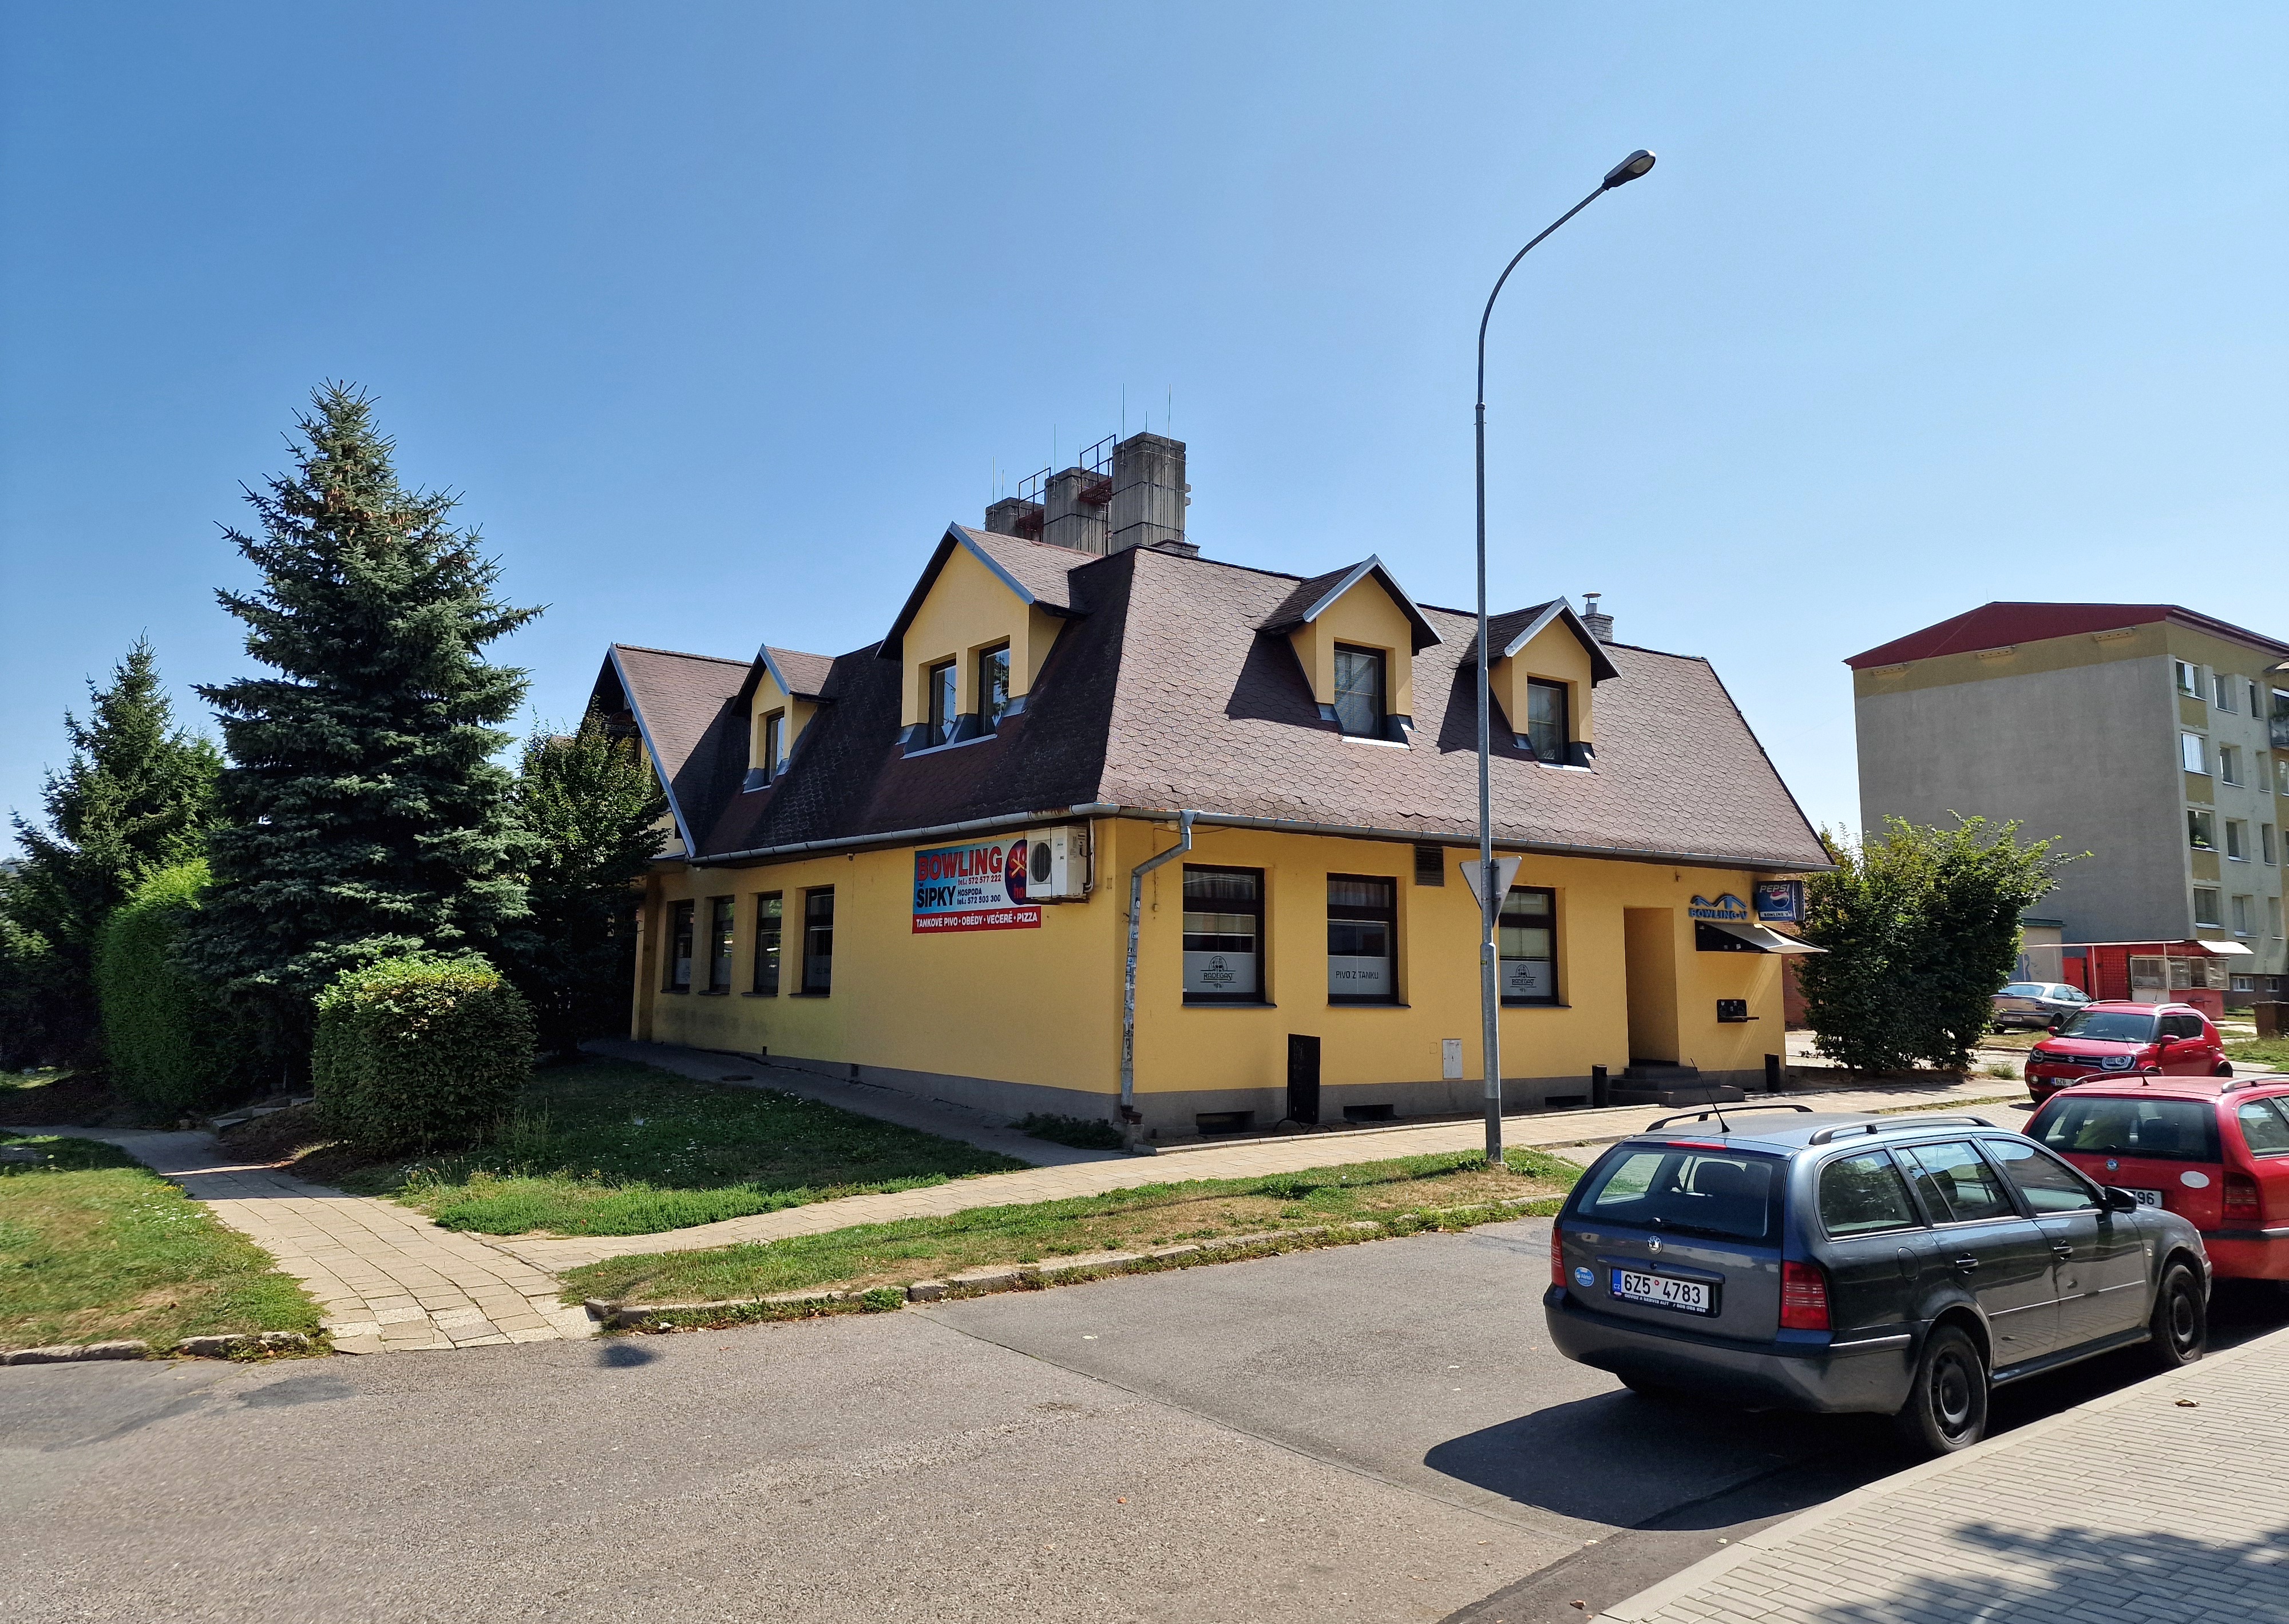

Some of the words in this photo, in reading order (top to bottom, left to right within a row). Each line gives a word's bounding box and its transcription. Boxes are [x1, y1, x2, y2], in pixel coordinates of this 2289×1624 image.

[917, 846, 1003, 881] BOWLING
[957, 888, 983, 897] HOSPODA
[1759, 884, 1790, 893] PEPSI
[916, 882, 956, 908] ŠIPKY
[967, 896, 977, 904] 572
[916, 915, 943, 928] TANKOVÉ
[944, 917, 958, 926] PIVO
[961, 913, 983, 926] OBĚDY
[1016, 912, 1037, 922] PIZZA
[1203, 972, 1234, 981] RADEGAST
[1336, 971, 1351, 979] PIVO
[1358, 971, 1379, 979] TANKU
[1624, 1274, 1651, 1295] 6Z5
[1662, 1281, 1701, 1304] 4783
